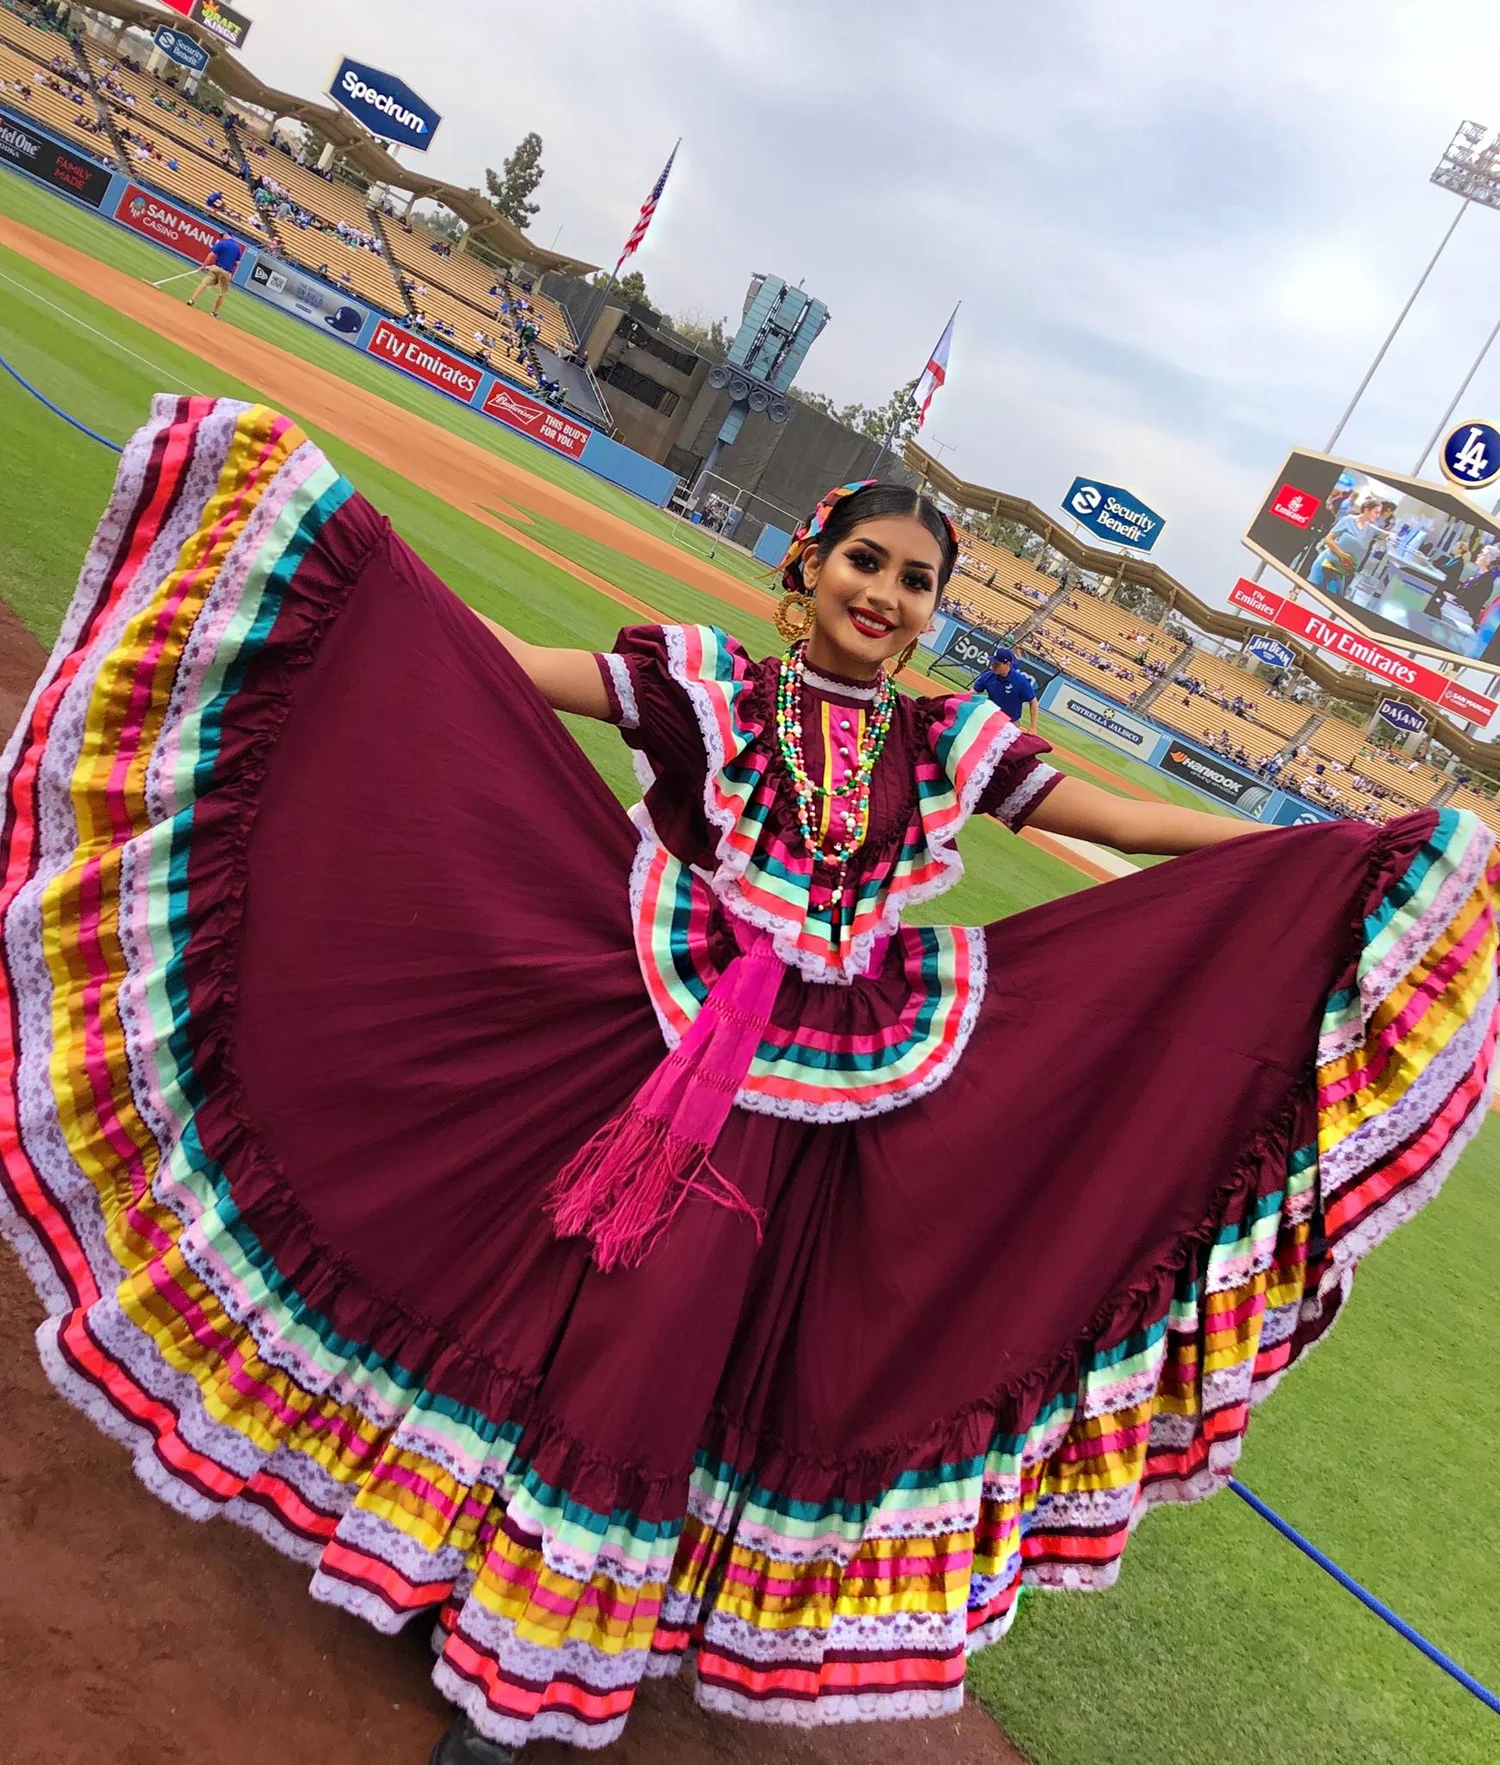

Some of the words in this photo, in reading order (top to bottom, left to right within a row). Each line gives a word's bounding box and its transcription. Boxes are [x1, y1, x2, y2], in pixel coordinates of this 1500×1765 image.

[202, 9, 242, 35] DRAFT
[203, 17, 237, 42] KINGS
[173, 47, 198, 66] Benefit
[176, 39, 204, 60] Security
[342, 71, 427, 133] Spectrum
[15, 134, 38, 155] One
[54, 169, 85, 190] MADE
[56, 156, 92, 180] FAMILY
[143, 217, 179, 240] CASINO
[147, 204, 177, 228] SAN
[178, 220, 219, 249] MANU
[376, 327, 405, 357] Fly
[405, 342, 475, 392] Emirates
[496, 394, 535, 420] Budweiser
[540, 425, 557, 439] FOR
[557, 433, 574, 450] YOU.
[544, 414, 563, 430] THIS
[563, 424, 588, 444] BUD'S
[1453, 427, 1488, 479] LA
[1096, 510, 1143, 542] Benefit
[1104, 497, 1156, 532] Security
[1274, 503, 1307, 524] Emirates
[1234, 590, 1275, 616] Emirates
[1252, 590, 1266, 601] Fly
[1249, 638, 1269, 651] JIM
[1268, 640, 1291, 667] BEAM
[1304, 617, 1338, 647] Fly
[1337, 633, 1417, 684] Emirates
[1071, 703, 1107, 726] ESTRELLA
[1108, 721, 1139, 742] JALISCO
[1381, 703, 1423, 732] DASANI
[1190, 769, 1212, 784] driving
